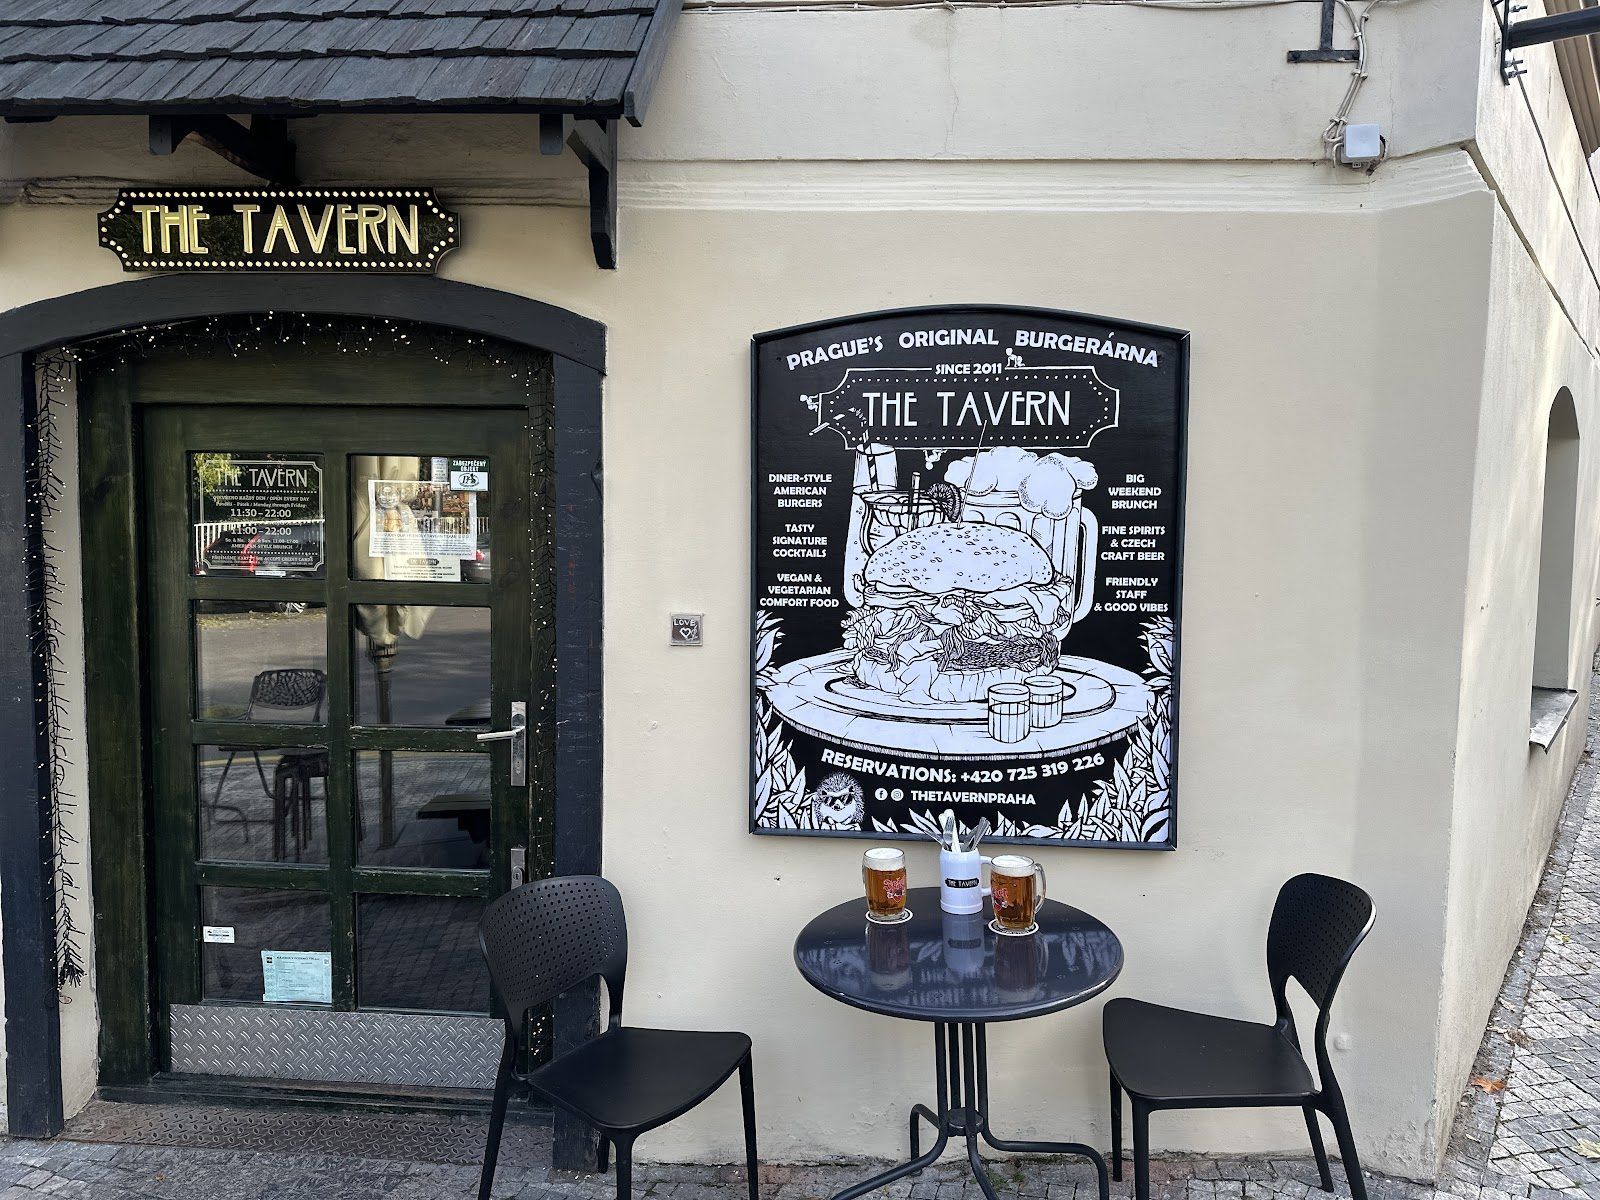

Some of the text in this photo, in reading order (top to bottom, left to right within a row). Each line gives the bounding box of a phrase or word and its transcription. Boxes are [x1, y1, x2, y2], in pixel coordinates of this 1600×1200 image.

[132, 204, 419, 254] THE TAVERN
[786, 329, 1159, 371] PRAGUE'S ORIGINAL BURGERÁRNA
[935, 362, 1002, 376] SINCE 2011
[862, 390, 1071, 427] THE TAVERN
[215, 468, 308, 488] THE TAVERN
[768, 473, 833, 483] DINER-STYLE
[1125, 474, 1145, 483] BIG
[773, 486, 827, 496] AMERICAN
[1108, 487, 1162, 496] WEEKEND
[777, 499, 823, 508] BURGERS
[1111, 500, 1158, 509] BRUNCH
[230, 508, 257, 517] 11:30
[264, 509, 292, 518] 22:00
[264, 527, 292, 536] 22:00
[785, 523, 815, 533] TASTY
[1101, 526, 1166, 535] FINE SPIRITS
[772, 536, 828, 546] SIGNATURE
[1110, 539, 1156, 548] & CZECH
[772, 549, 827, 558] COCKTAILS
[1100, 552, 1165, 561] CRAFT BEER
[776, 573, 823, 583] VEGAN &
[1105, 577, 1159, 587] FRIENDLY
[767, 585, 831, 595] VEGETARIAN
[1115, 590, 1148, 599] STAFF
[759, 597, 840, 608] COMFORT FOOD
[1093, 602, 1169, 612] & GOOD VIBES
[673, 618, 696, 627] LOVE
[821, 748, 1105, 784] RESERVATIONS: +420 725 319 226
[910, 790, 1037, 805] THETAVERNPRAHA
